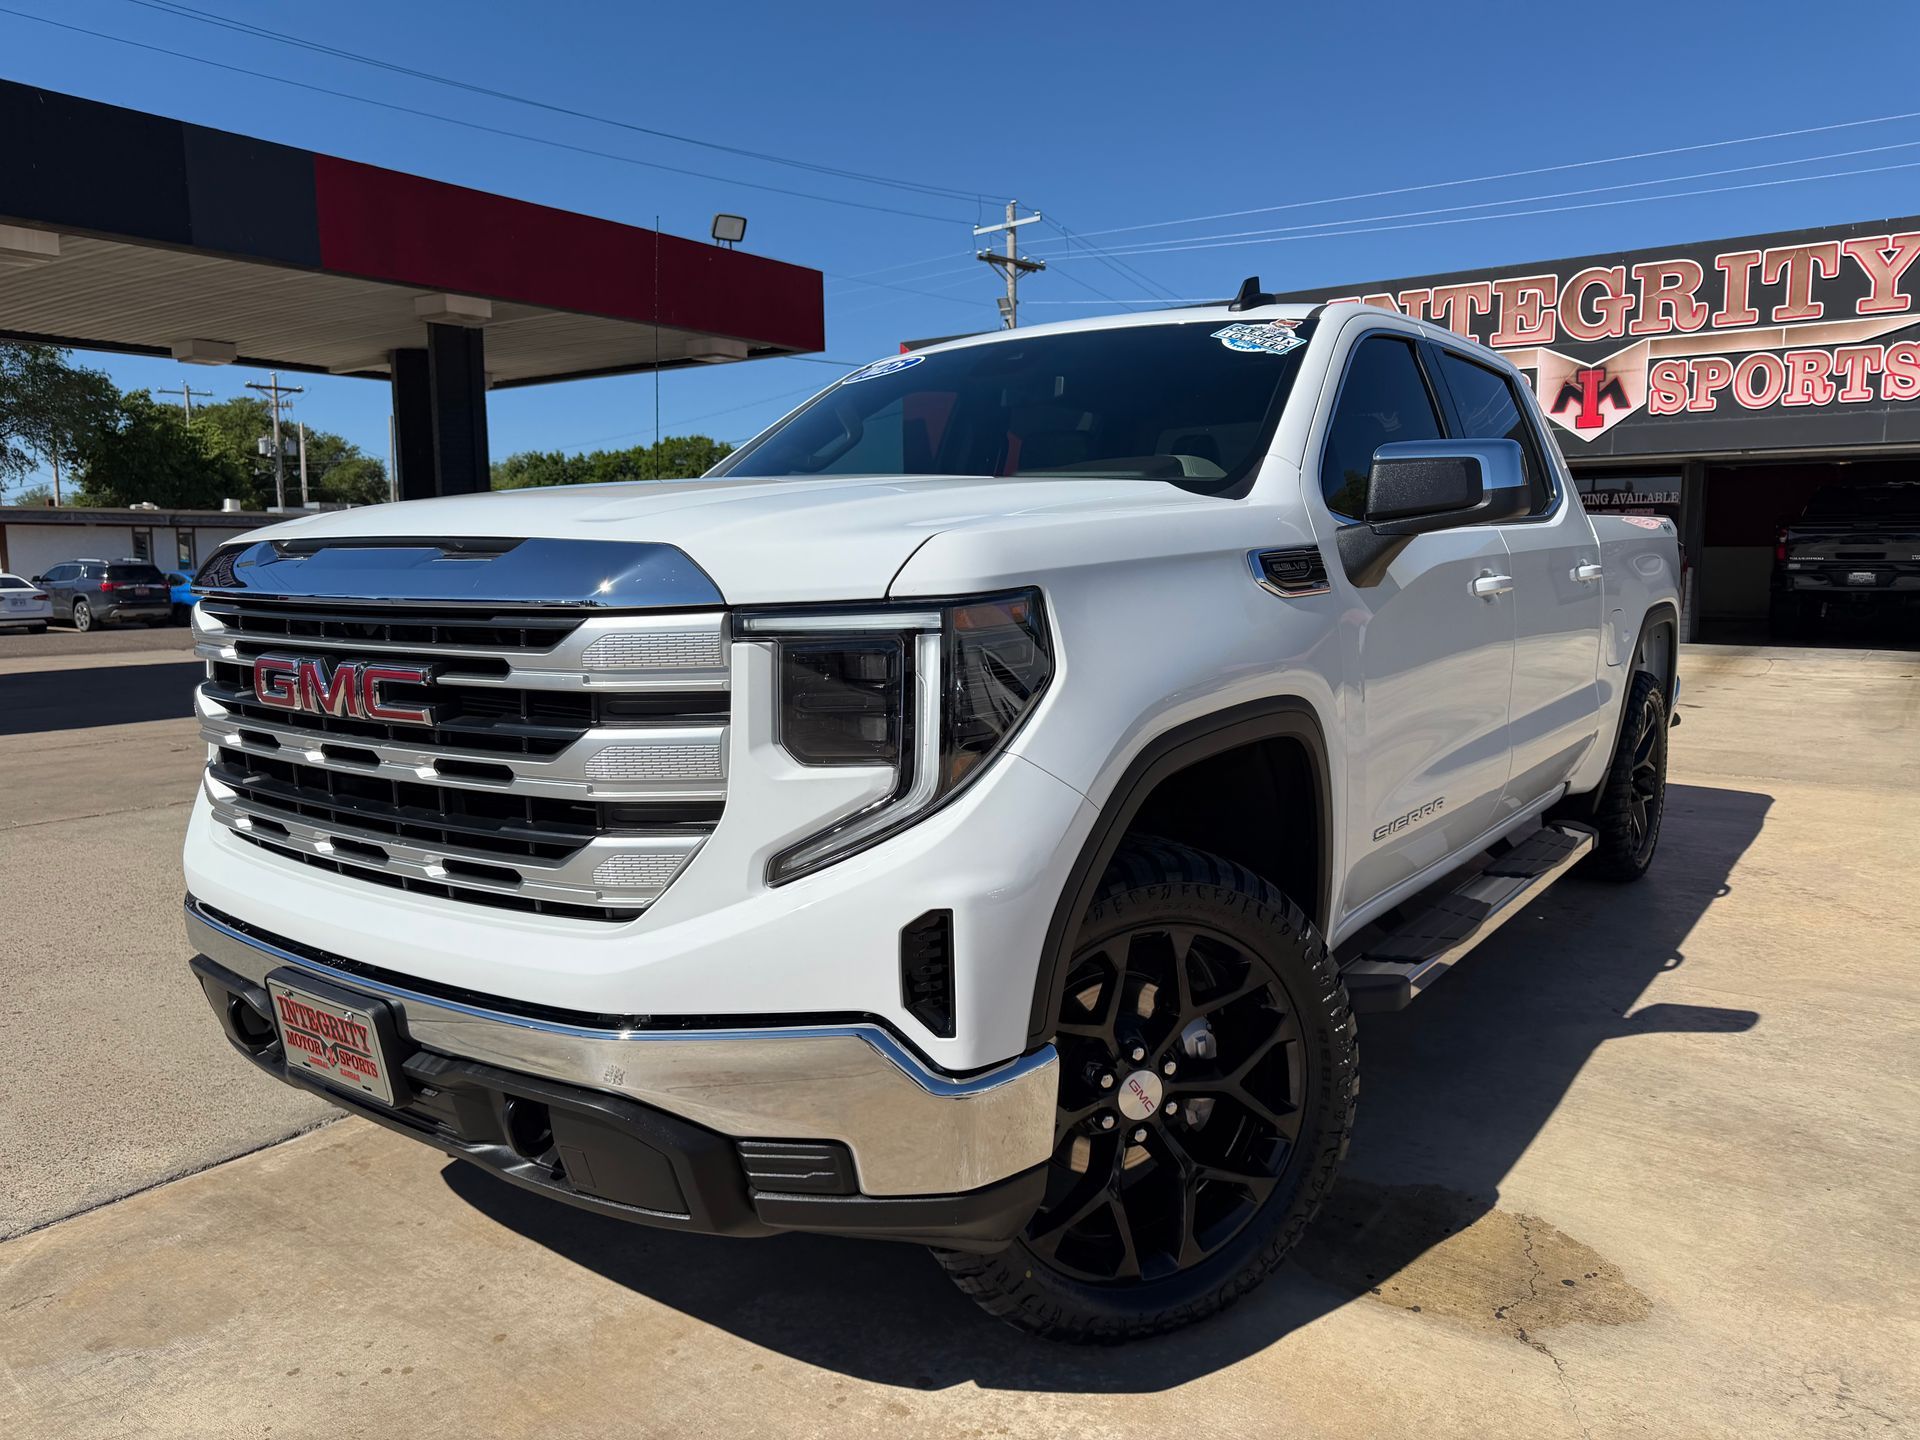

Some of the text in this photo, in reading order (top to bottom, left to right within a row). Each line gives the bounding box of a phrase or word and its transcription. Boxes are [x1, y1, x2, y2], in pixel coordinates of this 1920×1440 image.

[1327, 232, 1920, 347] TEGRITY
[1649, 340, 1920, 416] SPORTS
[254, 654, 434, 727] GMC
[1372, 796, 1445, 842] SIERRA
[276, 995, 371, 1054] INTEGRITY
[284, 1029, 323, 1057] MOTOR
[338, 1049, 379, 1079] SPORTS
[1128, 1079, 1155, 1113] GMC
